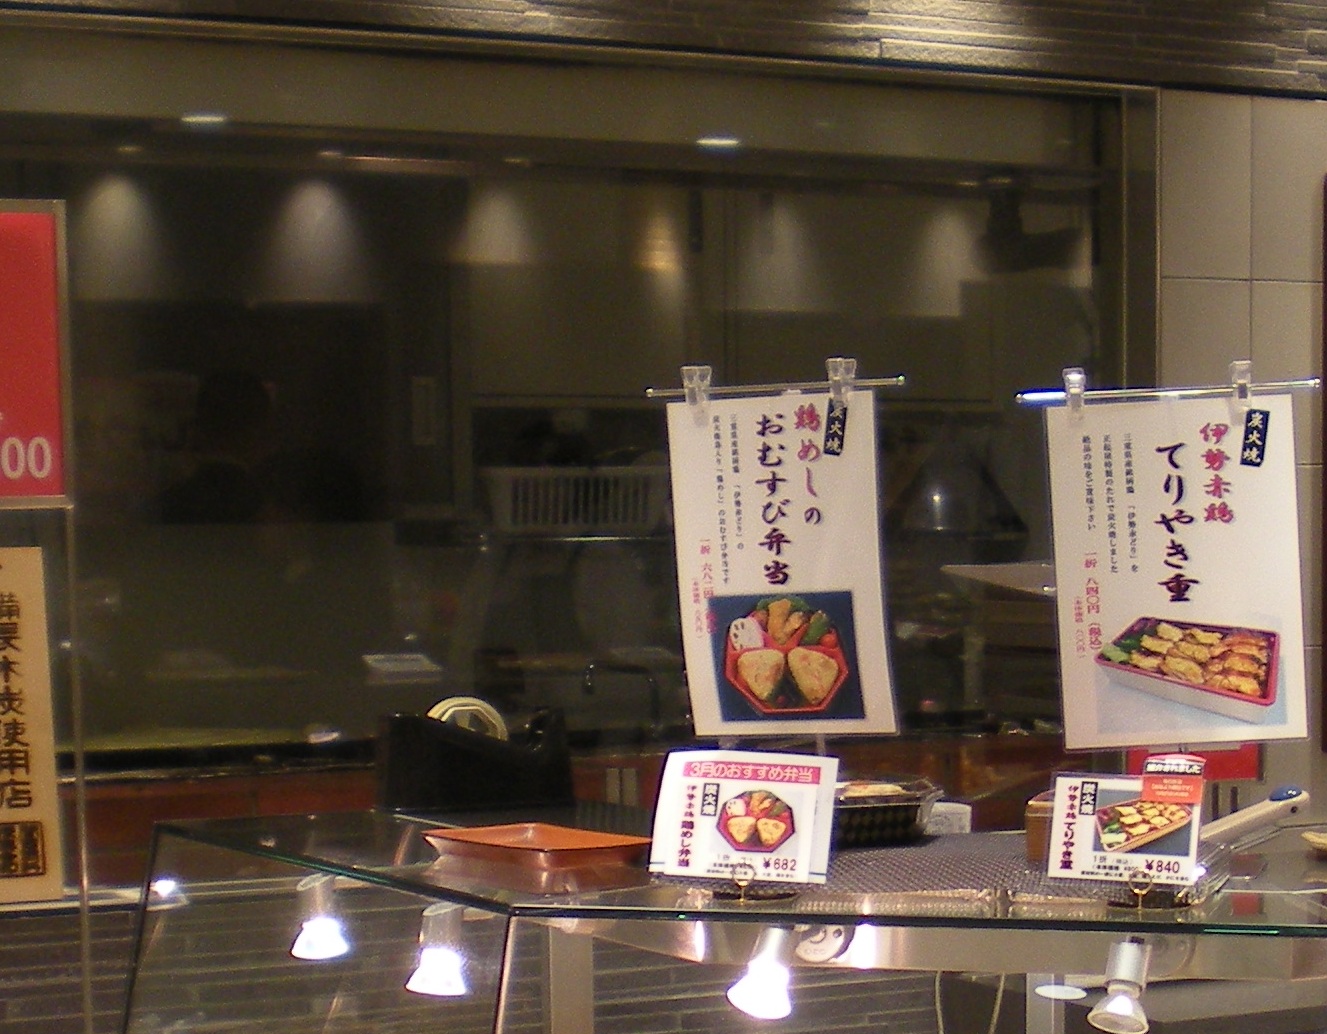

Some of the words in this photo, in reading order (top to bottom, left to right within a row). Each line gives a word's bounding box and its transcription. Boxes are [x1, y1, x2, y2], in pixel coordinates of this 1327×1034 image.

[1242, 411, 1264, 464] 炭火焼
[756, 412, 791, 586] おむすび弁当
[1154, 441, 1200, 604] てりやき重
[690, 761, 814, 782] 3月のおすすめ弁当
[763, 856, 797, 872] ¥682
[1145, 859, 1180, 874] ¥840
